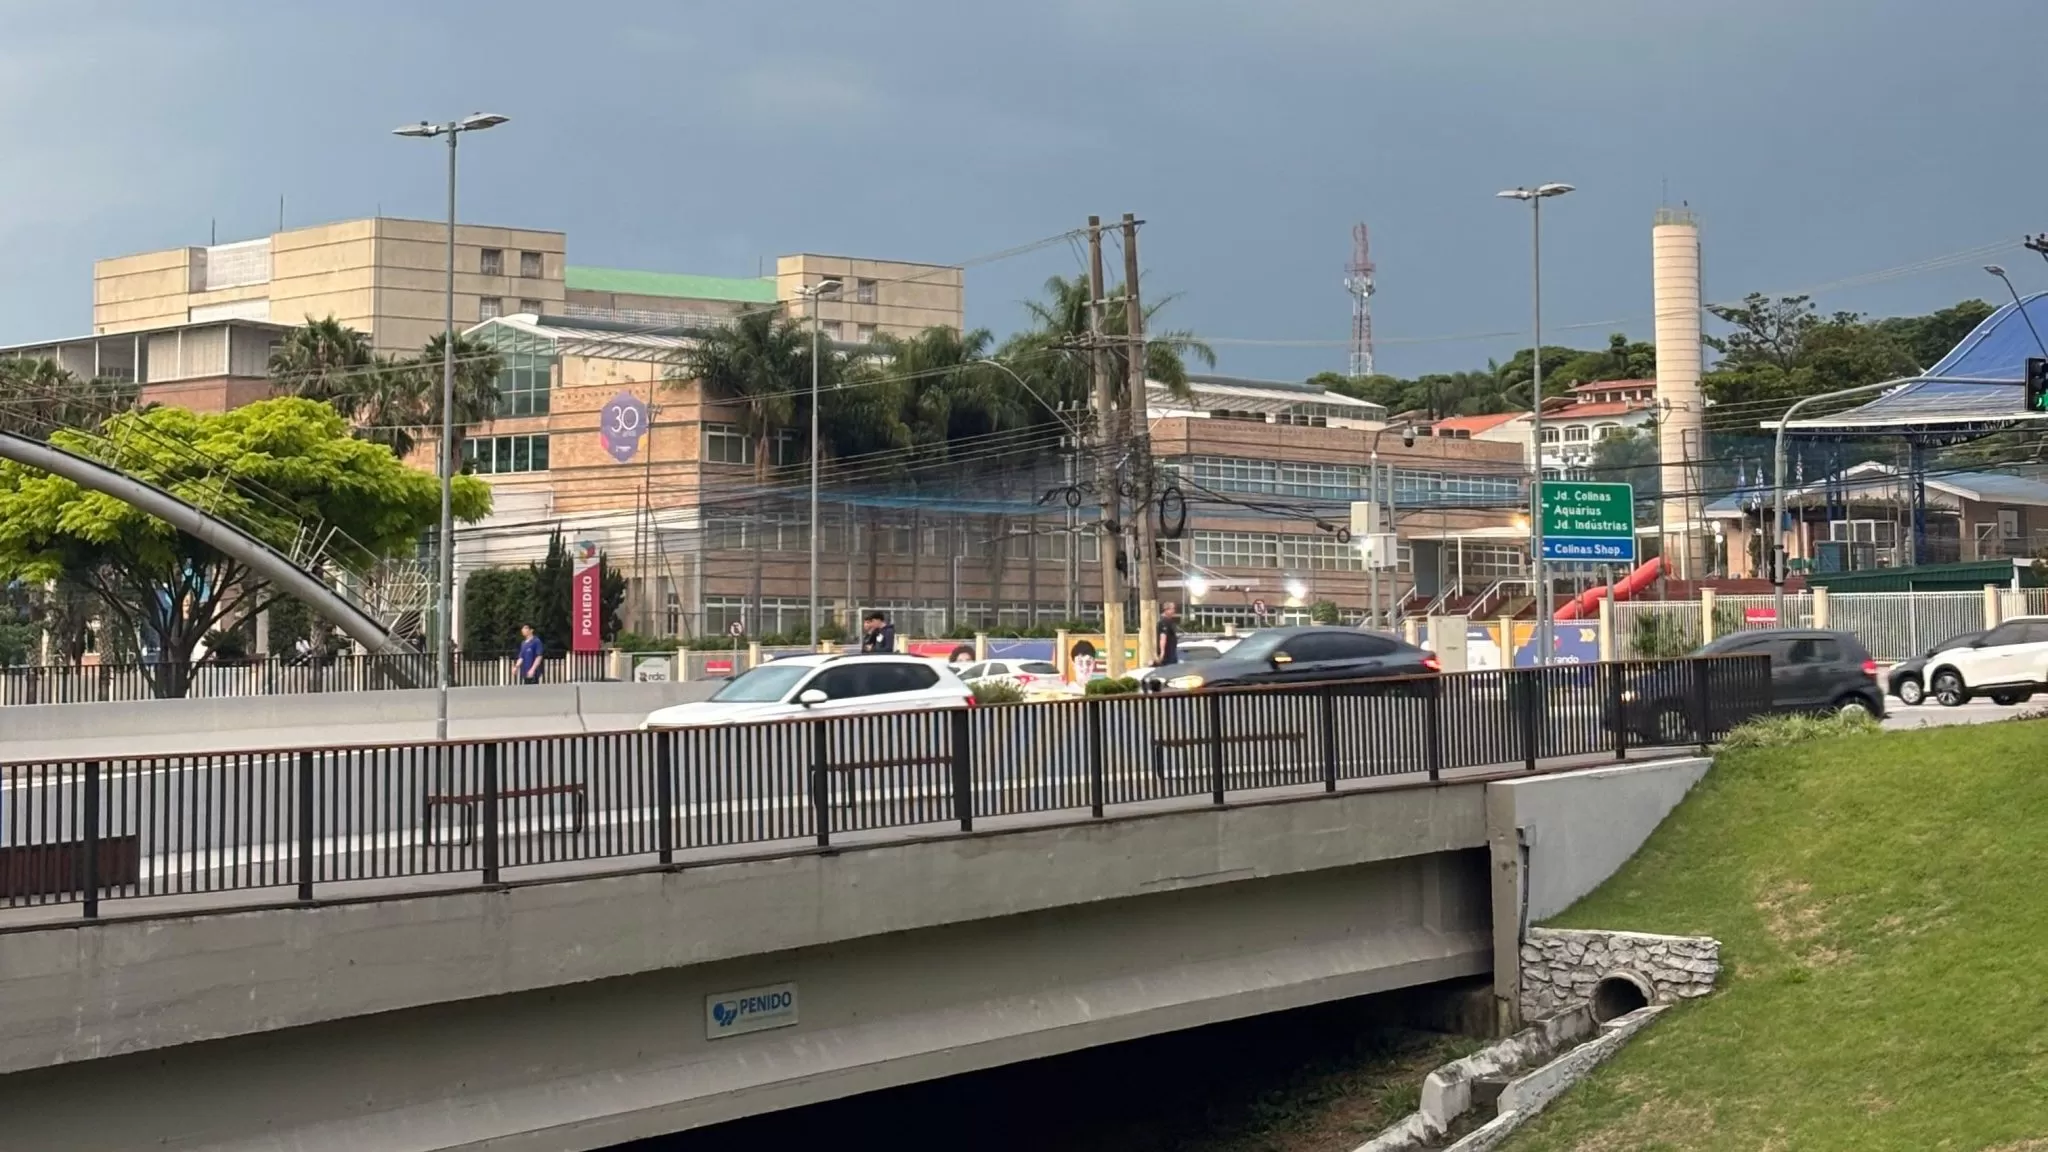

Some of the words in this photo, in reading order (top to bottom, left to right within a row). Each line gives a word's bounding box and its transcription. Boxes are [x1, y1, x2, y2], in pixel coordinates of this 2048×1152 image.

[611, 406, 639, 432] 30
[1554, 490, 1571, 501] Jd.
[1574, 490, 1612, 502] Colinas
[1554, 503, 1602, 517] Aquárius
[1554, 519, 1571, 530] Jd.
[1574, 518, 1628, 532] Indústrias
[1554, 543, 1593, 555] Colinas
[1594, 543, 1624, 557] Shop.
[582, 575, 592, 636] POLIEDRO
[740, 991, 792, 1015] PENIDO
